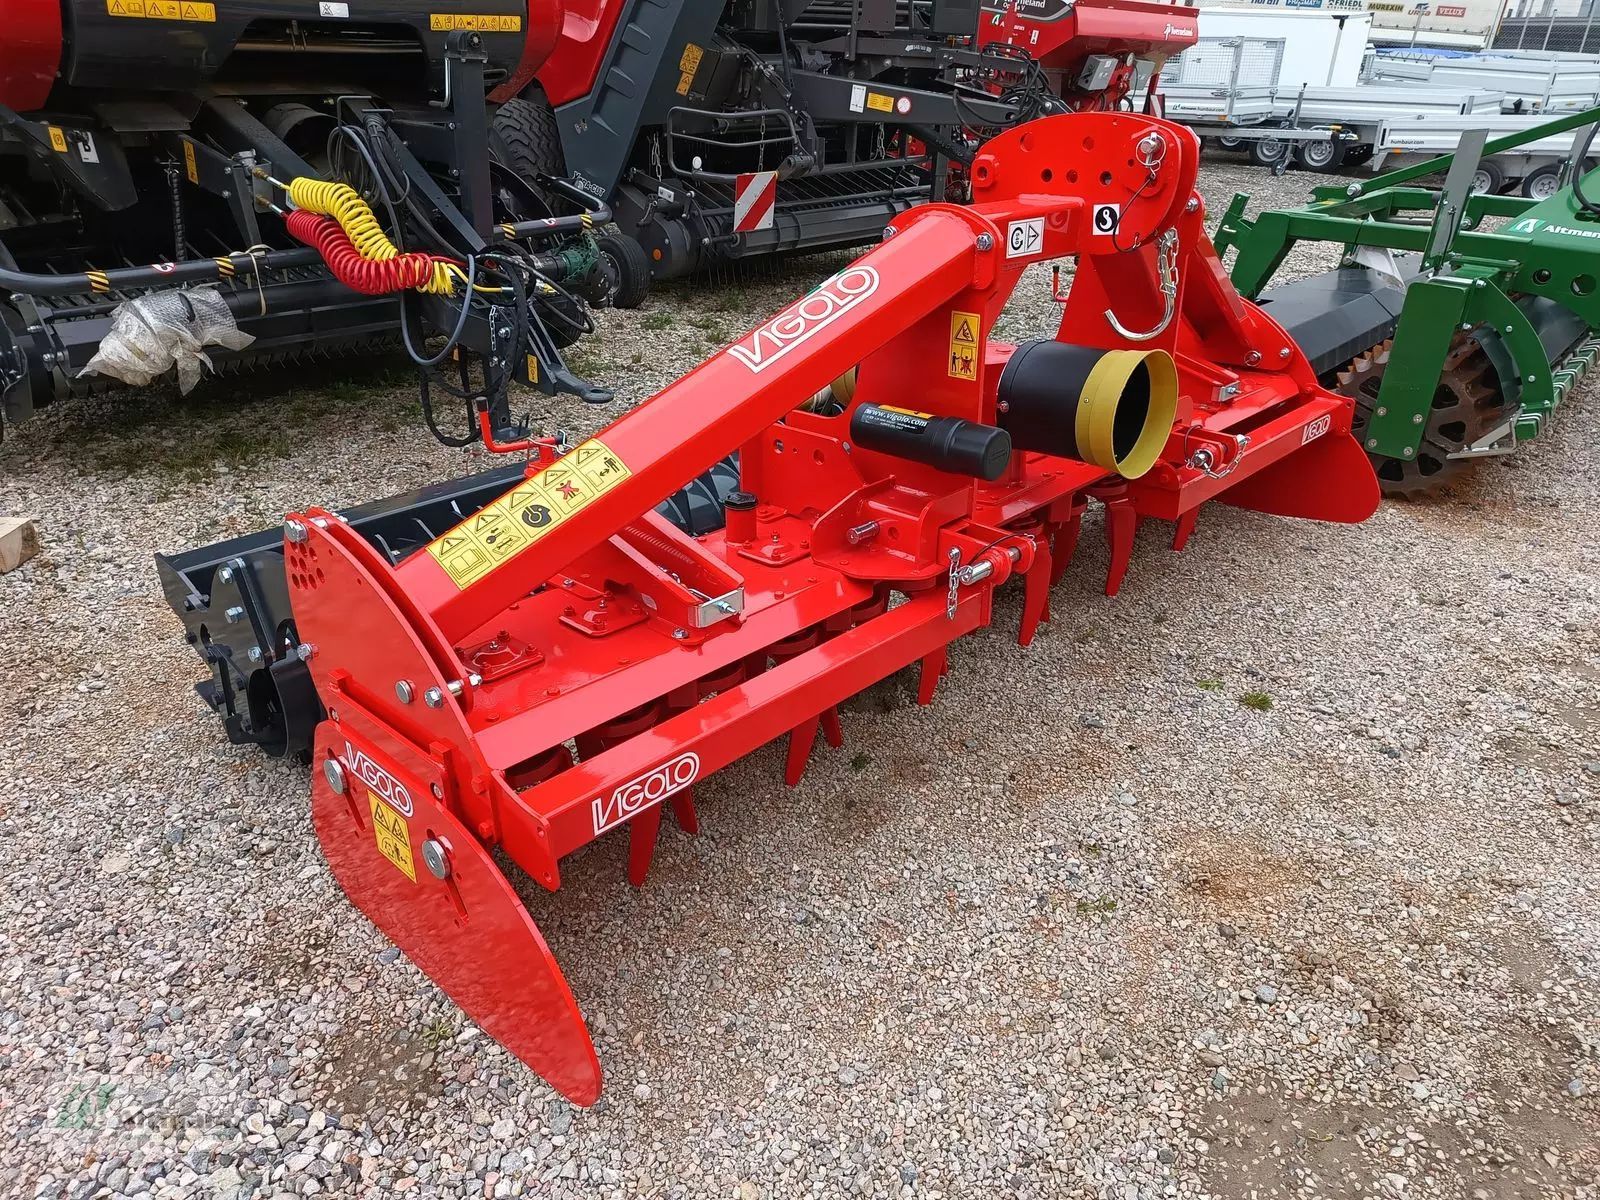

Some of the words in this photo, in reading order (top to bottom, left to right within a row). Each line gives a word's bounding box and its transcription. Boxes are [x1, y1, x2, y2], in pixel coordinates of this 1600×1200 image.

[1368, 3, 1404, 11] MUREXIN
[1439, 7, 1464, 15] VELUX
[729, 267, 878, 371] VIGOLO
[864, 408, 928, 427] www.vigolo.com
[1302, 415, 1330, 445] VIGOLO
[346, 741, 413, 817] VIGOLO
[592, 752, 699, 836] VIGOLO
